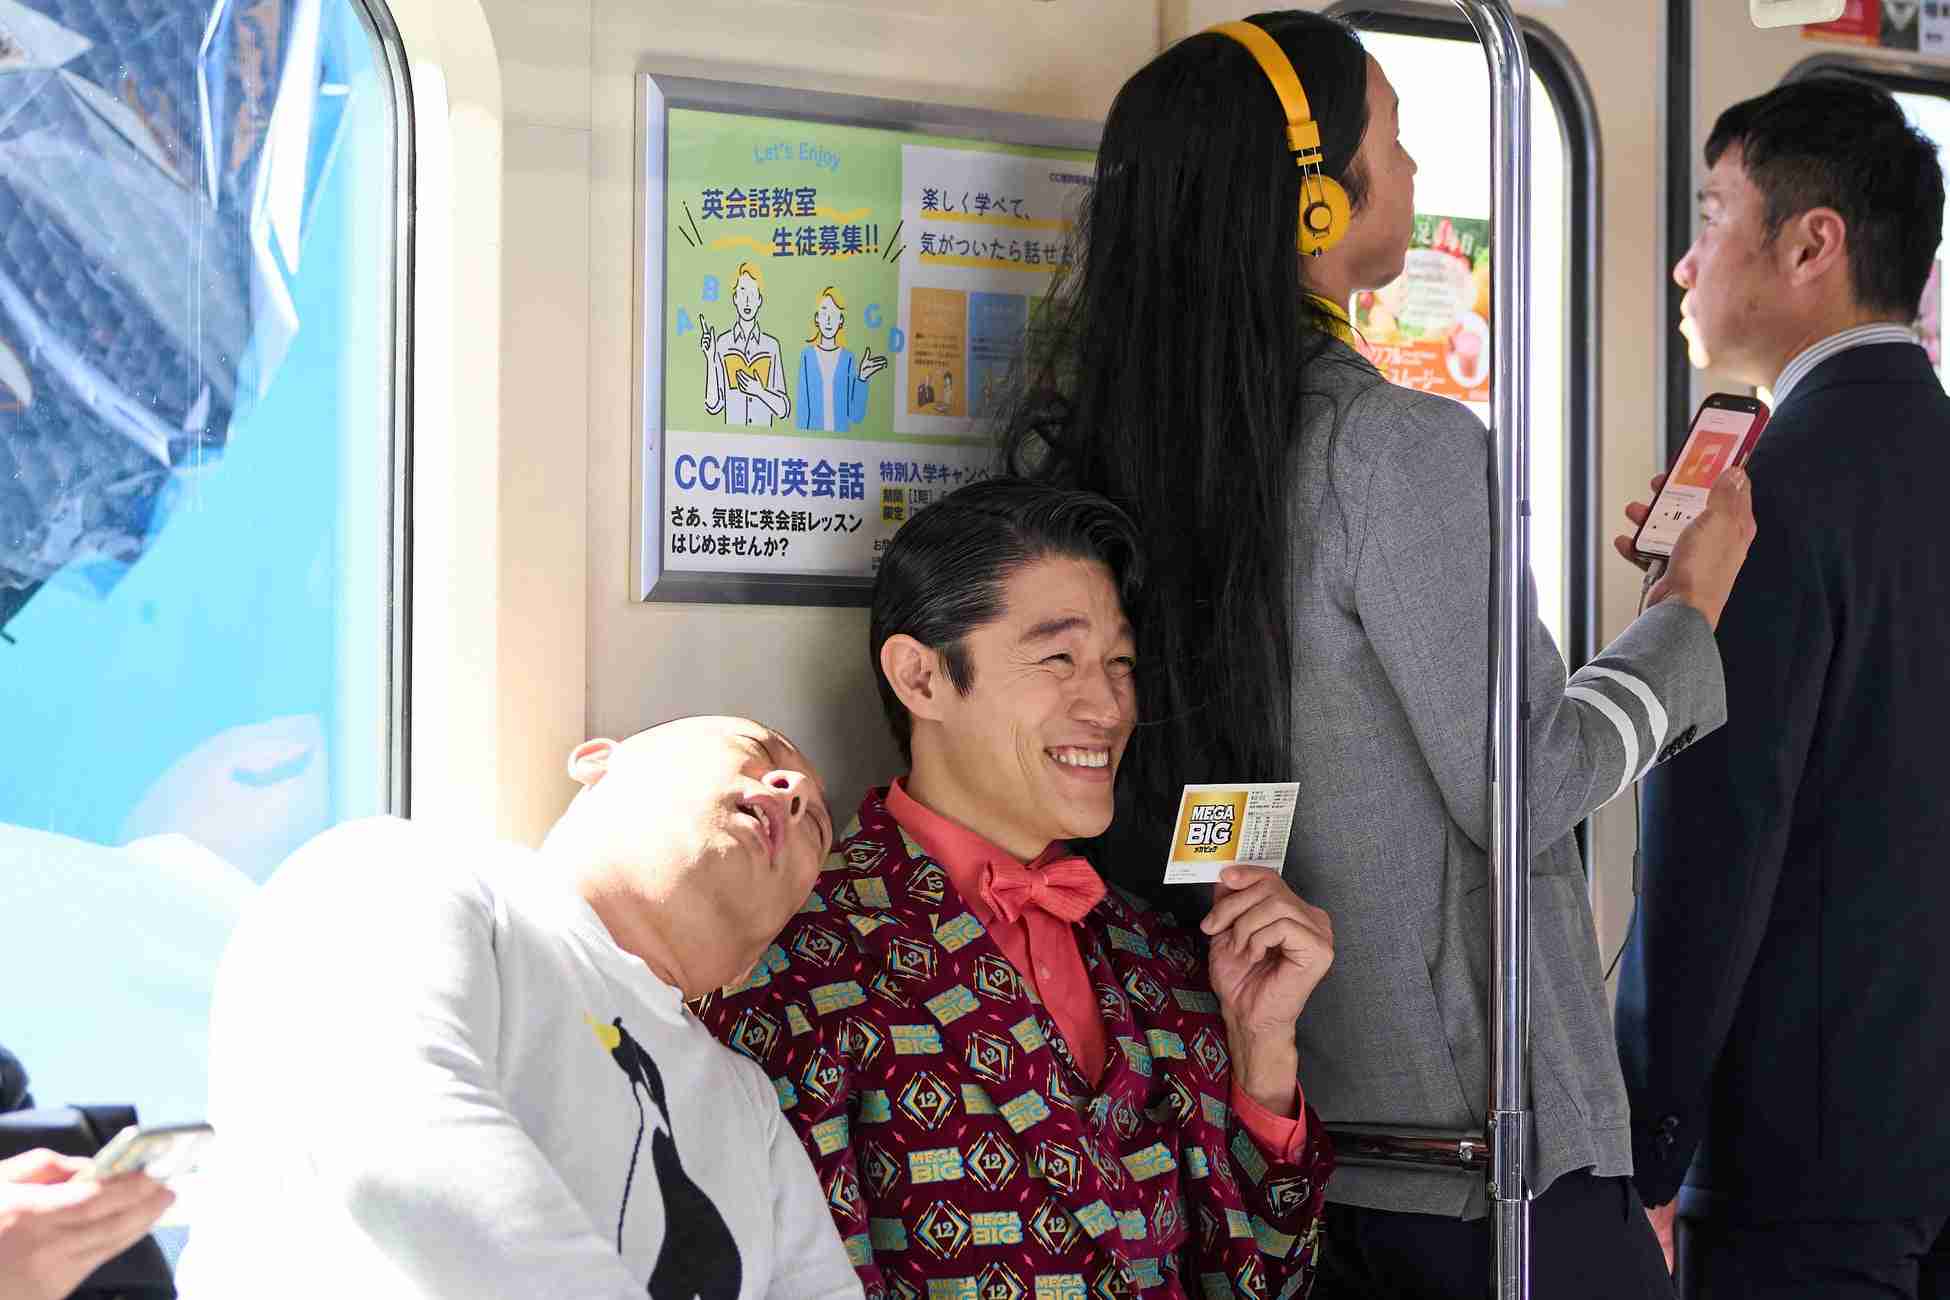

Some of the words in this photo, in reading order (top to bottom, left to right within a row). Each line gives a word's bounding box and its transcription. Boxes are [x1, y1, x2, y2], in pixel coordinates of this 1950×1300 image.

[752, 142, 794, 165] Let's
[799, 142, 842, 174] Enjoy
[702, 186, 817, 220] 英会話教室
[922, 187, 1031, 221] 楽しく学べて、
[674, 454, 864, 500] CC個別英会話
[671, 505, 863, 533] さあ、気軽に英会話レッスン
[1191, 805, 1235, 821] MEGA
[1186, 821, 1232, 845] BIG
[819, 1067, 839, 1085] 12
[917, 1091, 938, 1109] 12
[982, 1153, 1002, 1170] 12
[933, 1221, 955, 1239] 12
[1046, 1217, 1067, 1233] 12
